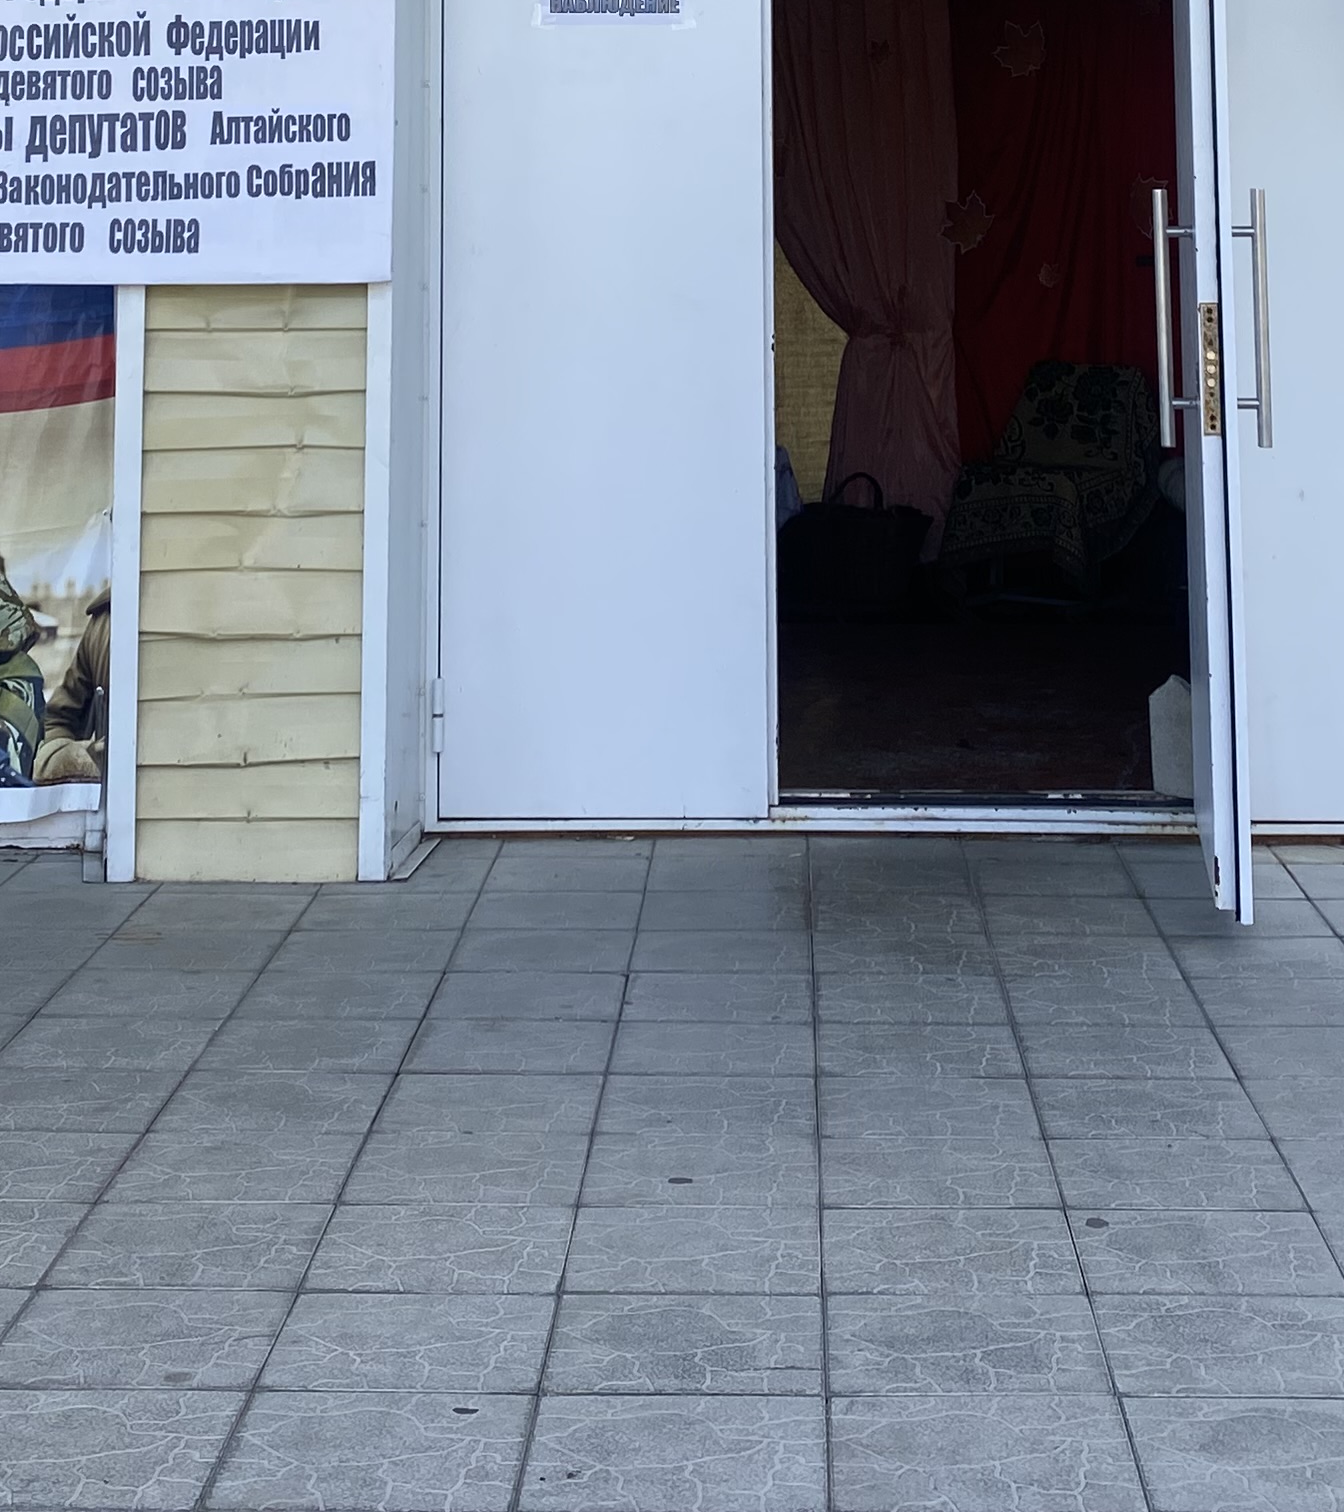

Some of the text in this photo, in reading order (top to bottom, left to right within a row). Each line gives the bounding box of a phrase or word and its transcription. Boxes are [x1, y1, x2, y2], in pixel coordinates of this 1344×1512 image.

[167, 14, 320, 62] Федерации
[132, 65, 223, 102] созыва
[25, 110, 187, 163] депутатов
[210, 108, 351, 146] Алтайского
[108, 218, 200, 255] созыва
